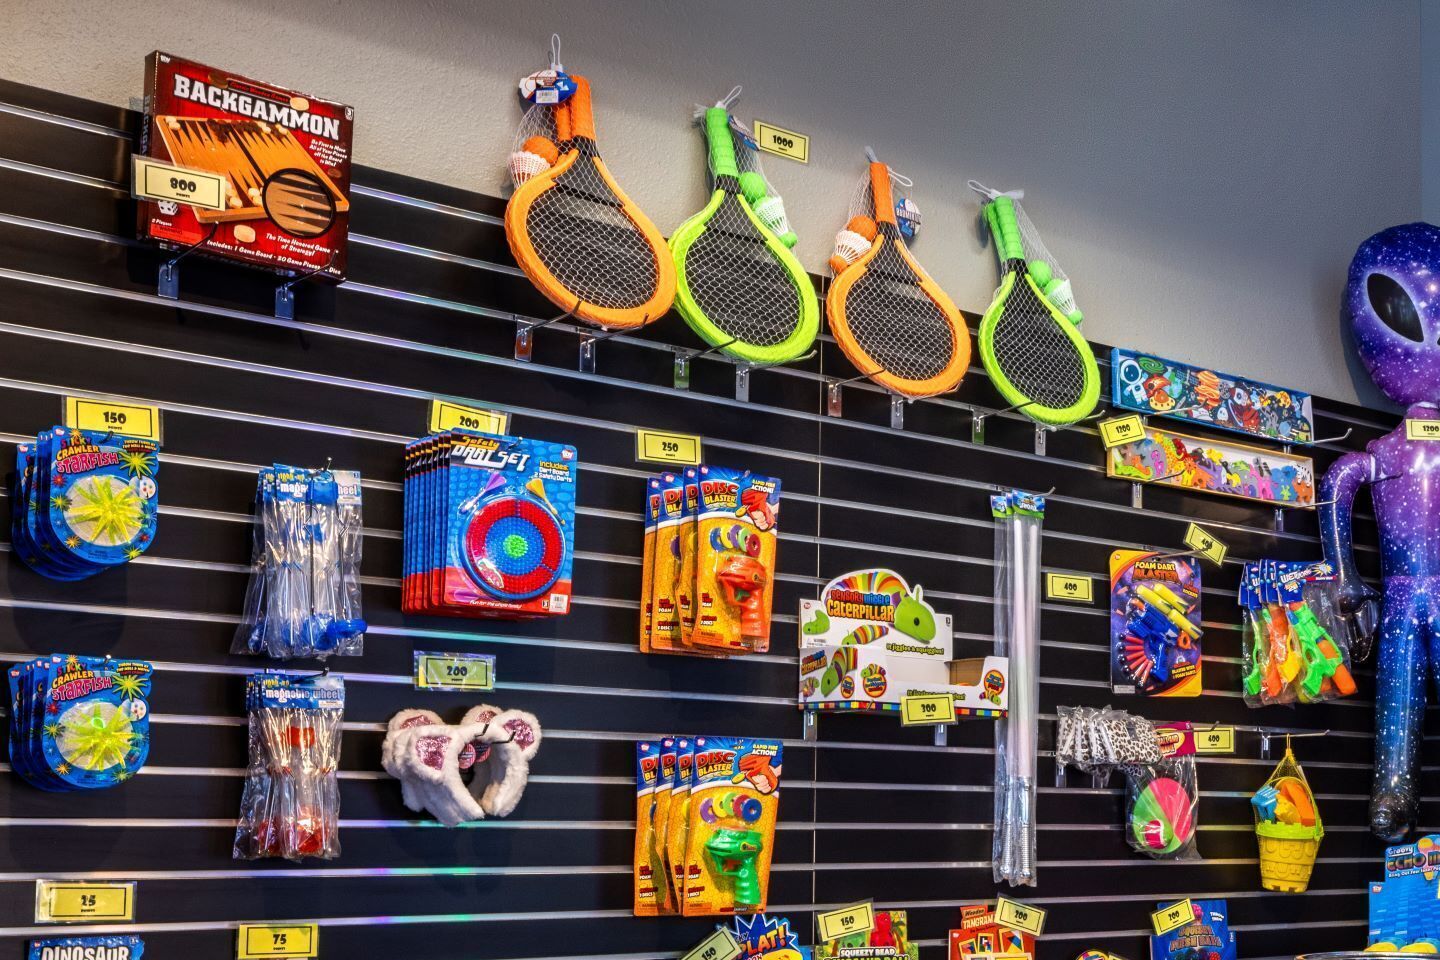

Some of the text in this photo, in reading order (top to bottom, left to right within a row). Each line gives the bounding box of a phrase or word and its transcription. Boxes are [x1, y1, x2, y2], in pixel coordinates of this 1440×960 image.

[174, 74, 339, 140] BACKGAMMON
[773, 134, 793, 148] 1000
[103, 411, 126, 423] 150
[459, 416, 479, 429] 200
[61, 436, 92, 449] STICKY
[662, 441, 678, 452] 250
[56, 445, 99, 459] CRAWLER
[451, 445, 530, 471] DART SET
[57, 452, 120, 474] STARFISH
[701, 482, 738, 495] DISC
[703, 494, 738, 505] BLASTER
[447, 665, 467, 677] 200
[273, 934, 286, 944] 75
[840, 948, 895, 956] SQUEEZY BEAD
